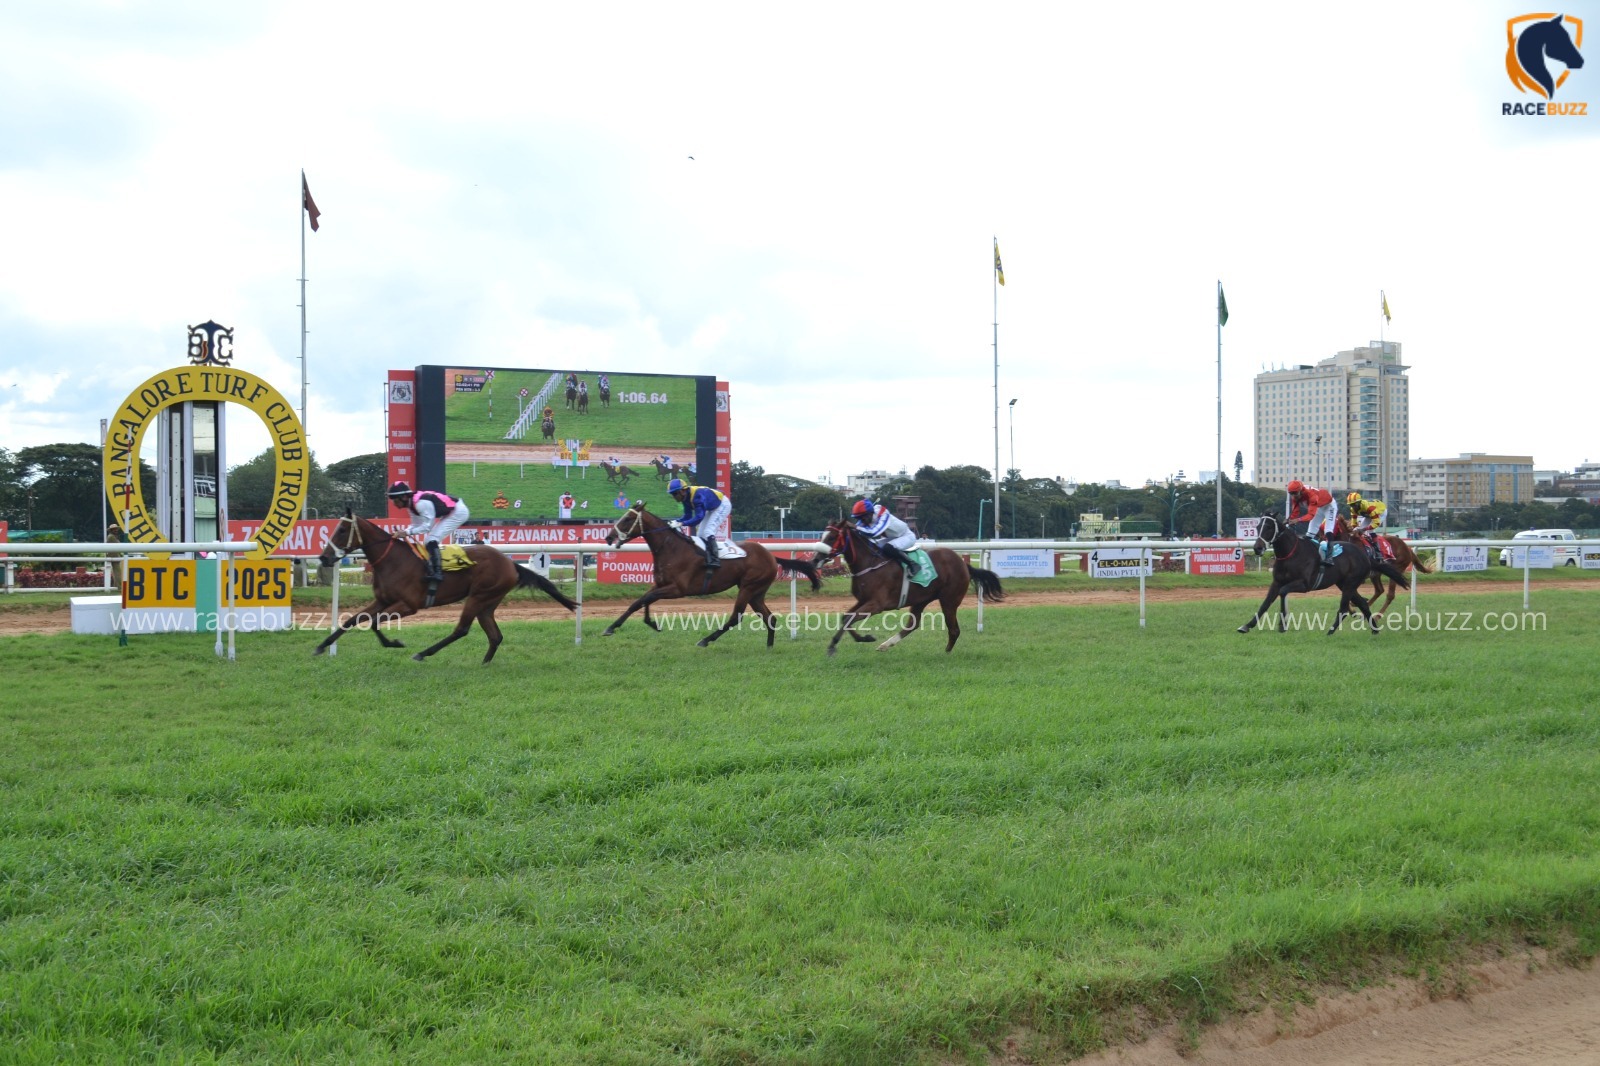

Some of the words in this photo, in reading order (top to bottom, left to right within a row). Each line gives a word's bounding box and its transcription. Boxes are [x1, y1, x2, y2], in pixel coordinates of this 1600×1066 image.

[200, 372, 268, 403] TURF
[617, 391, 668, 404] 1:06.64
[110, 372, 193, 498] BANGALORE
[265, 402, 302, 461] CLUB
[514, 500, 521, 508] 6
[580, 500, 588, 508] 4
[255, 469, 303, 554] TROPHY
[508, 529, 564, 542] ZAVARAY
[568, 529, 579, 542] S.
[1091, 551, 1098, 562] 4
[1234, 549, 1241, 560] 5
[1475, 547, 1480, 557] 7
[539, 553, 545, 568] 1
[1099, 559, 1148, 568] EL-O-MATC
[128, 567, 189, 601] BTC
[226, 567, 287, 600] 2025
